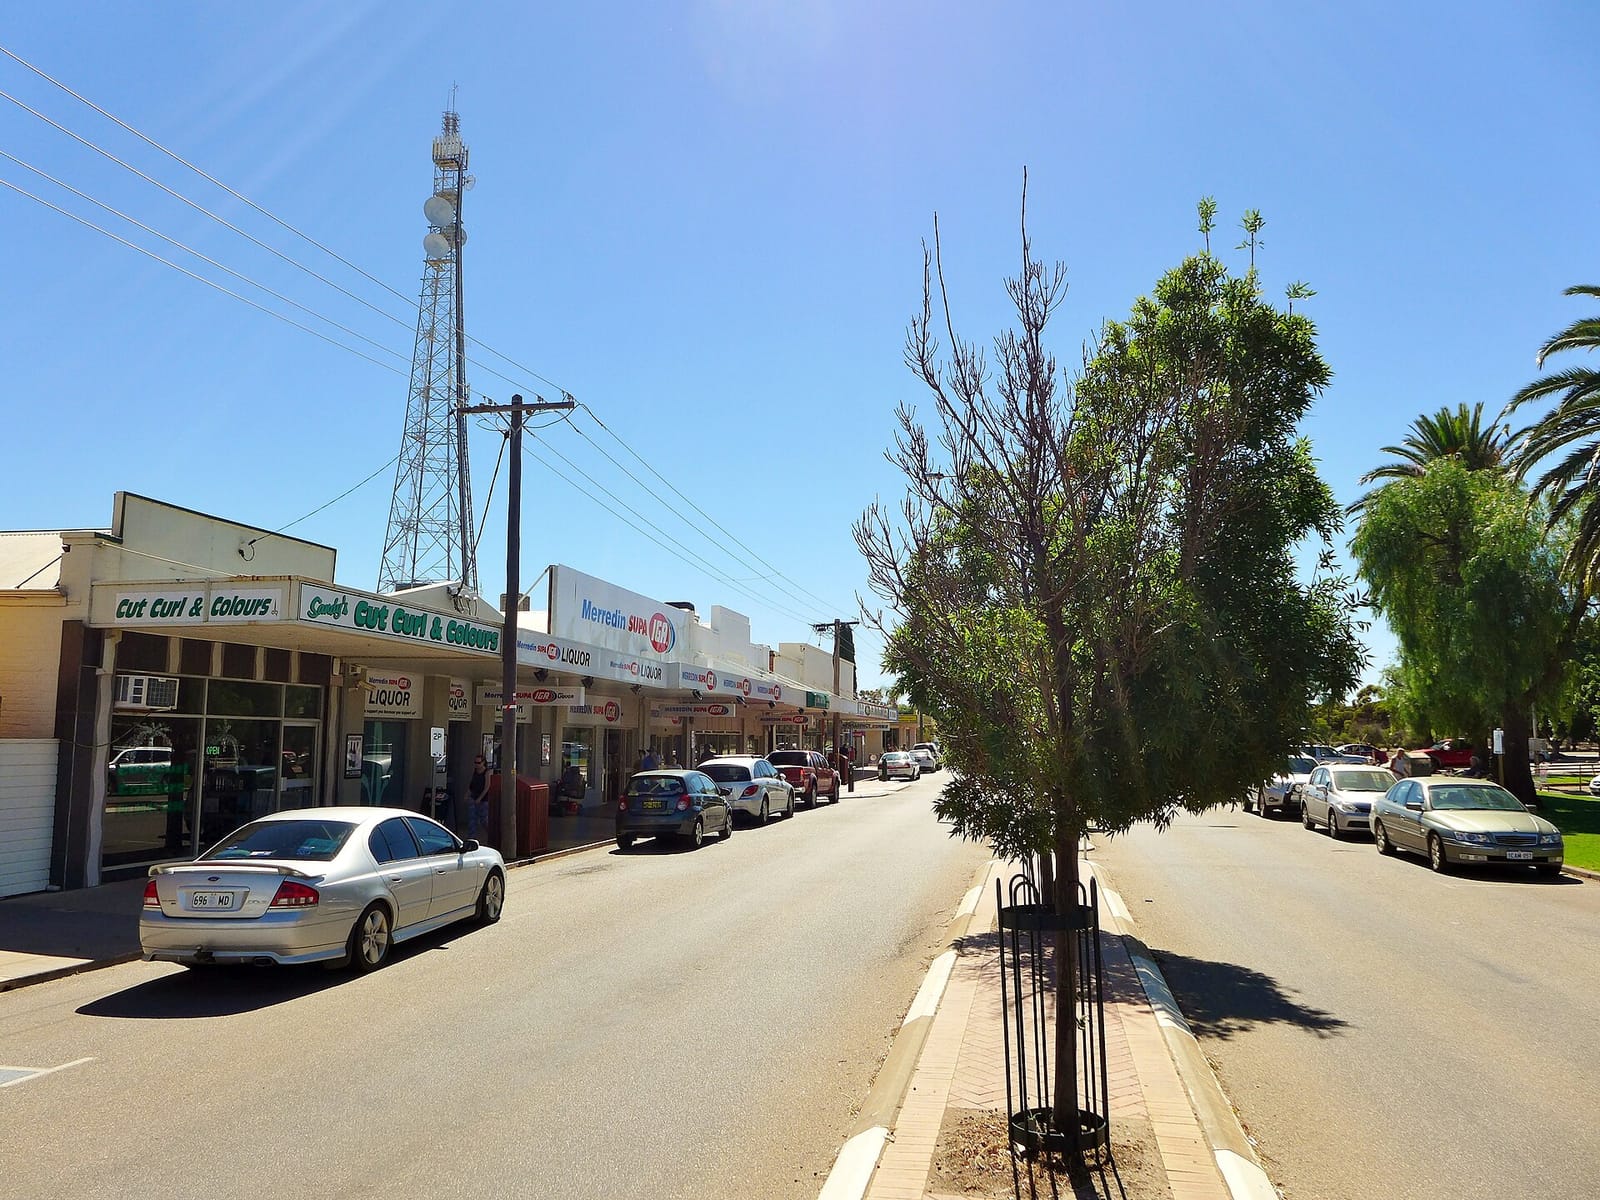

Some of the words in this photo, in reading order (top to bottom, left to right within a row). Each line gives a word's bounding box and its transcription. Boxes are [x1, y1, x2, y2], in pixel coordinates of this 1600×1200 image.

[116, 598, 148, 618] Cut
[150, 597, 187, 618] Curl
[189, 597, 203, 617] &
[211, 596, 272, 616] Colours
[307, 595, 349, 620] Sandy's
[354, 601, 389, 631] Cut
[392, 608, 427, 638] Curl
[430, 617, 442, 641] &
[446, 620, 499, 651] Colours
[581, 599, 627, 630] Merredin
[628, 614, 648, 636] SUPA
[650, 618, 668, 644] IGA
[561, 647, 591, 667] LIQUOR
[641, 663, 662, 680] LIQUOR
[368, 690, 411, 707] LIQUOR
[449, 698, 467, 710] QUOR
[534, 691, 550, 700] IGA
[433, 733, 442, 741] 2P
[193, 895, 208, 906] 696
[217, 895, 230, 906] MD
